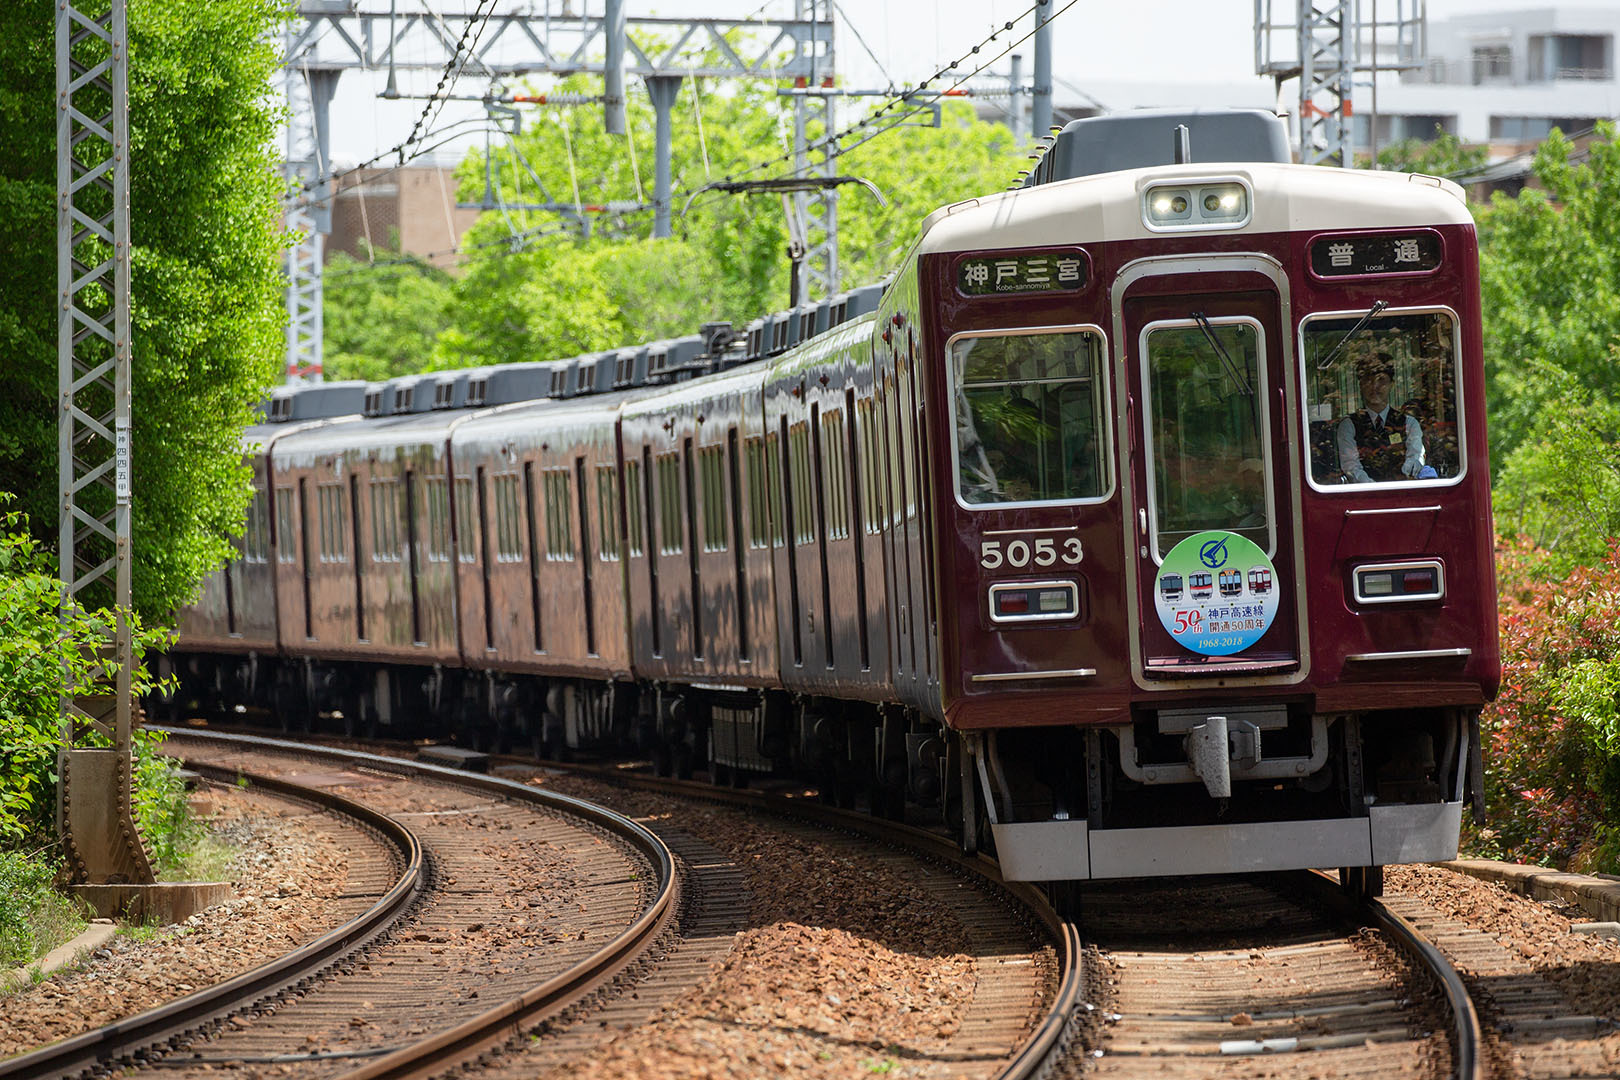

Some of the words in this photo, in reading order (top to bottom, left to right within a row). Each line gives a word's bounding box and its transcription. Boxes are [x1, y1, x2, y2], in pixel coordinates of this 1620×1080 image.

[1328, 239, 1420, 267] 普通
[965, 258, 1080, 286] 神戸三宮
[980, 537, 1084, 569] 5053
[1208, 605, 1264, 619] 神戸高速線
[1209, 619, 1265, 632] 開通50周年
[1198, 638, 1243, 649] 1968-2018
